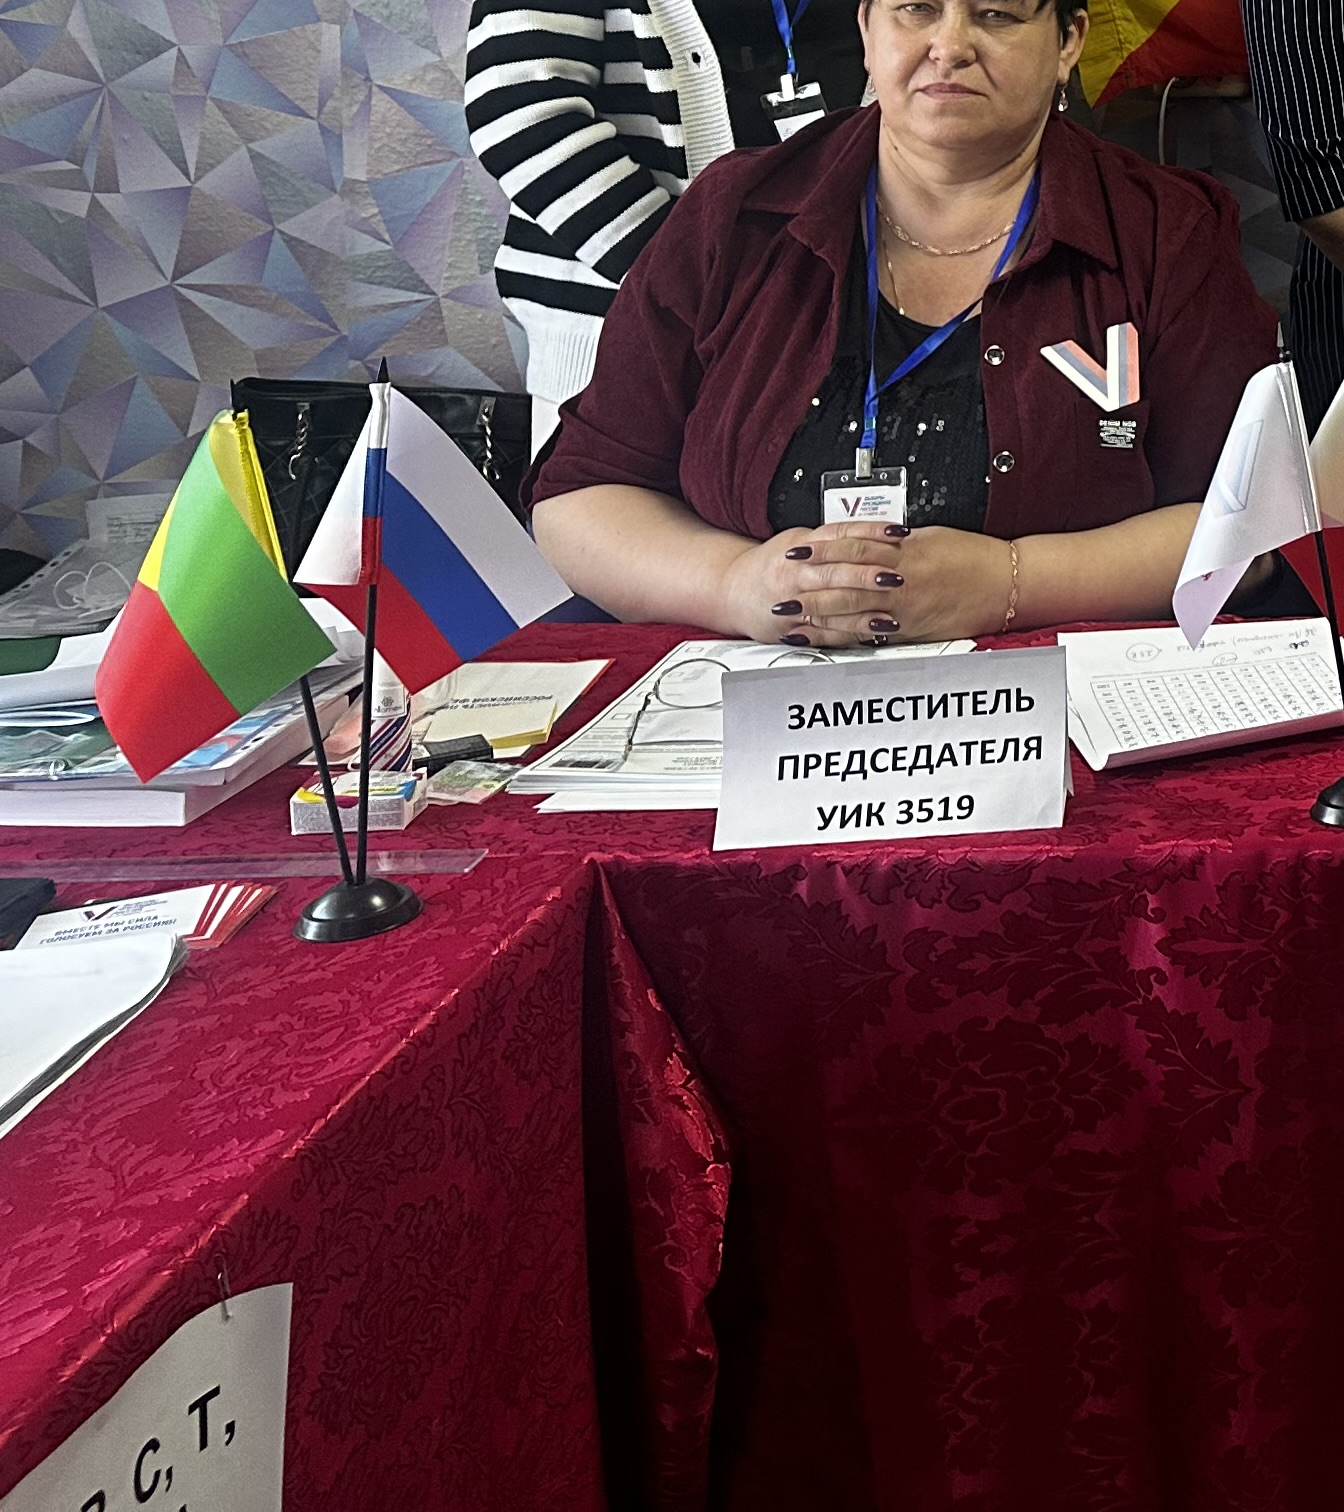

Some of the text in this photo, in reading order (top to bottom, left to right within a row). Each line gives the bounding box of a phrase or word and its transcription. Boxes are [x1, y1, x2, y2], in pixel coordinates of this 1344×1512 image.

[787, 687, 1036, 730] ЗАМЕСТИТЕЛЬ
[778, 735, 1044, 782] ПРЕДСЕДАТЕЛЯ
[816, 794, 975, 831] УИК 3519
